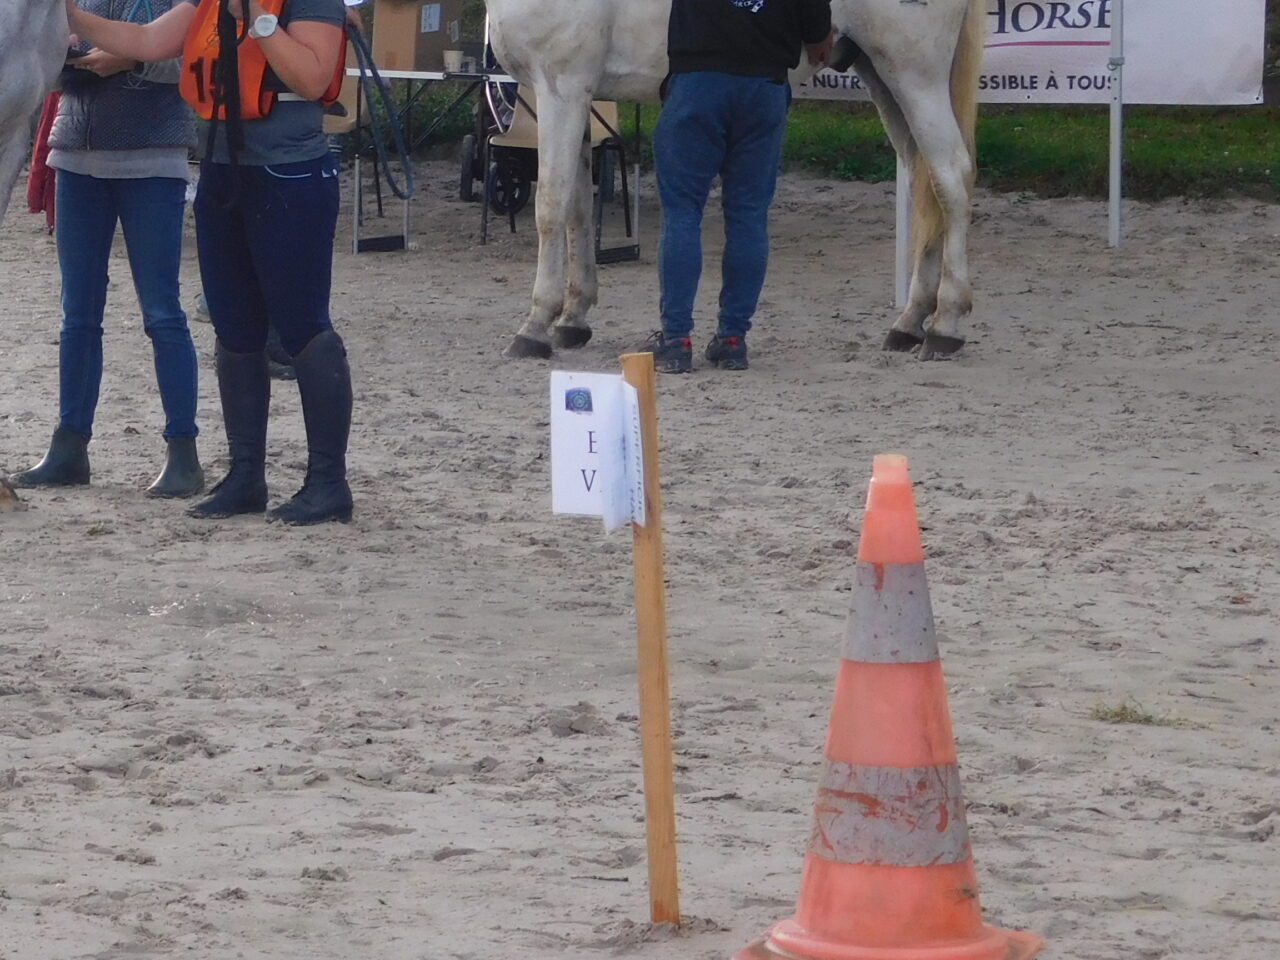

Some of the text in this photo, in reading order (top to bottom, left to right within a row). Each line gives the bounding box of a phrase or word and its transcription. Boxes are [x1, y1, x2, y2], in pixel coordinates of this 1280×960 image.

[813, 74, 866, 90] NUTR
[978, 75, 1038, 90] SSIBLE
[1045, 70, 1059, 90] À
[581, 468, 597, 492] V
